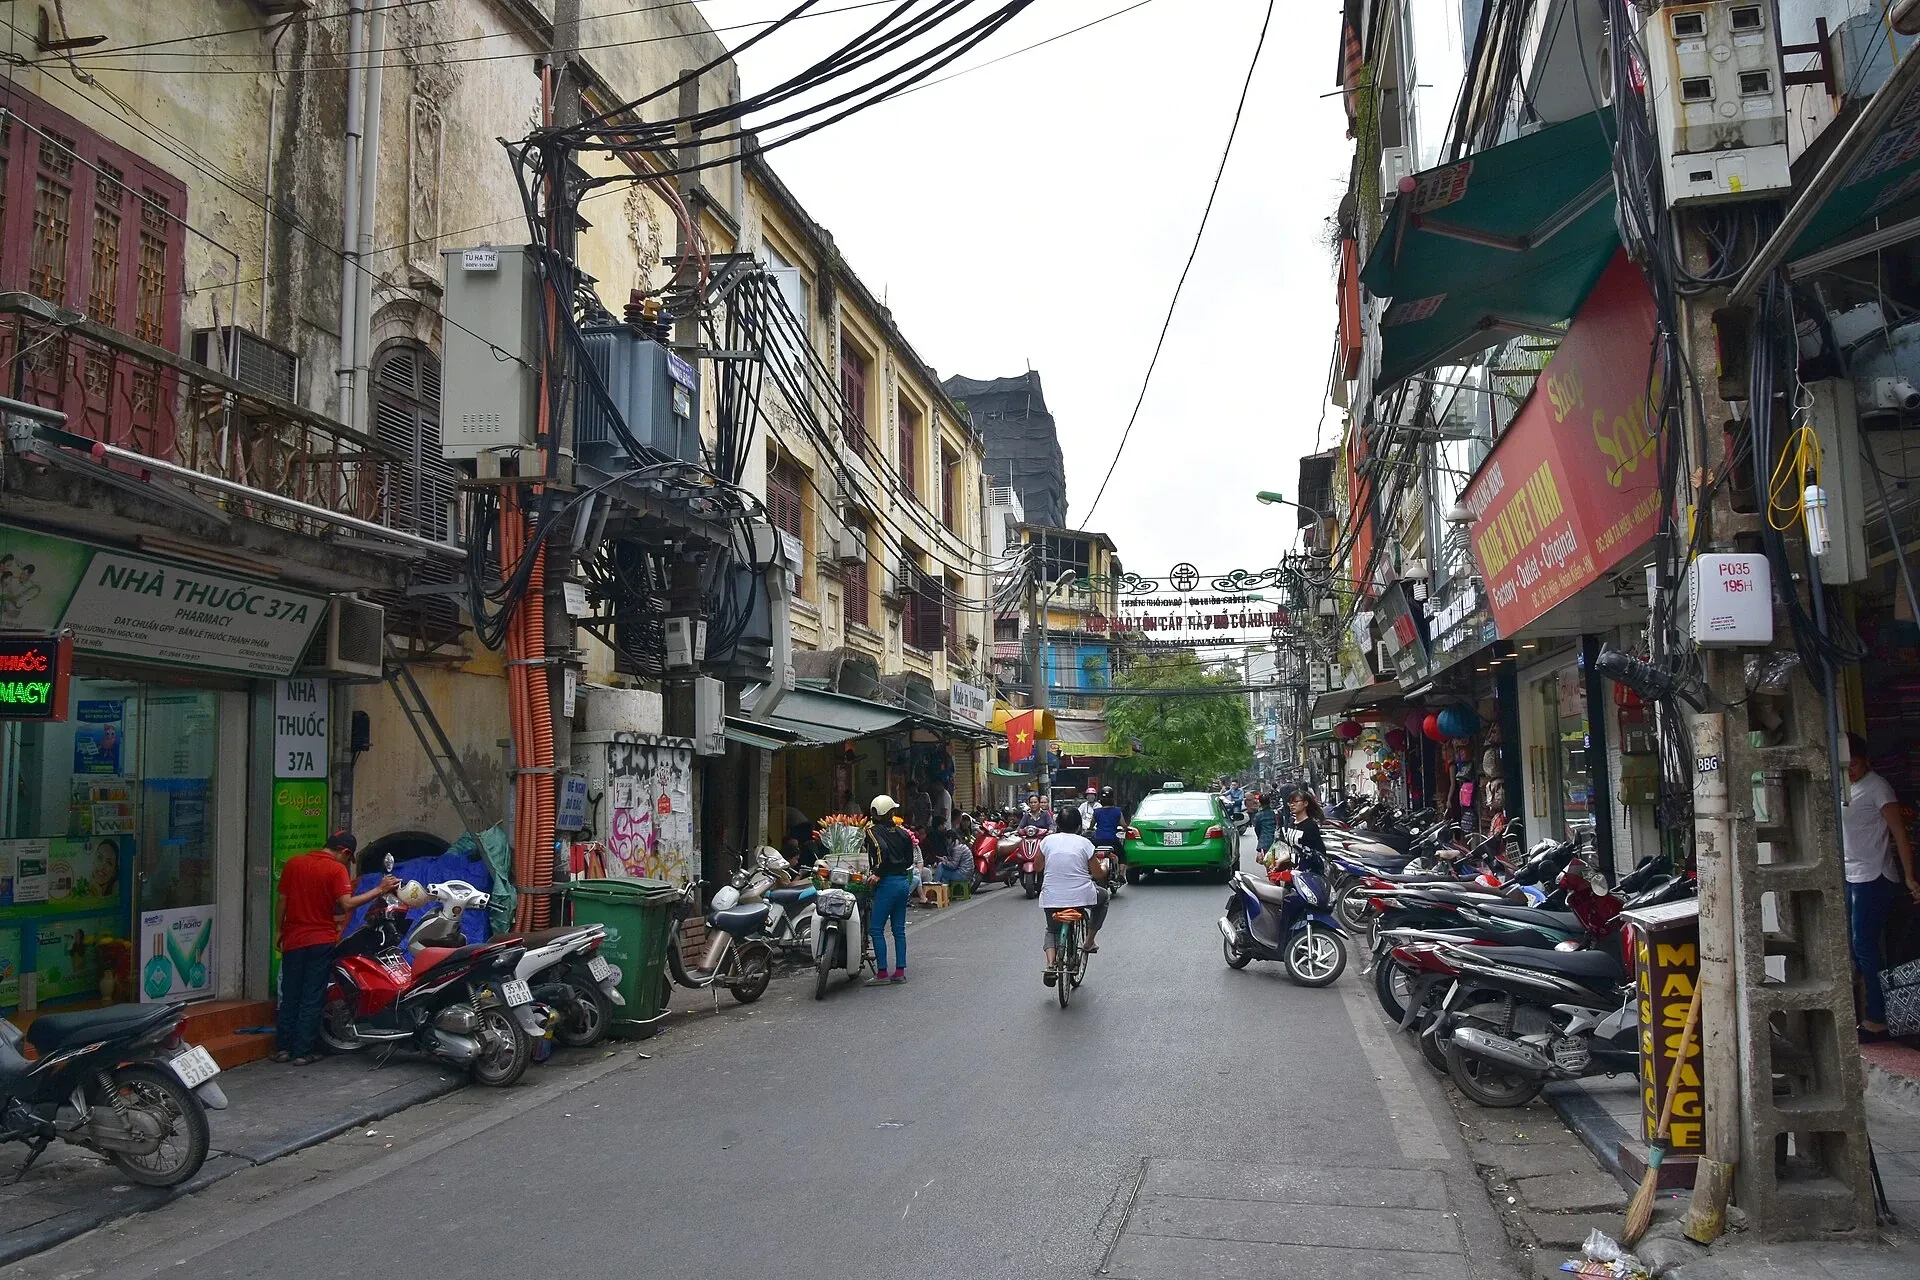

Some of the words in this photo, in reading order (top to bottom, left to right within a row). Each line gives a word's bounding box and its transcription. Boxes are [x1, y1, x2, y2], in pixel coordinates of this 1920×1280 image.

[1478, 520, 1508, 580] MADE
[1497, 509, 1519, 560] IN
[1526, 459, 1564, 531] NAM
[1492, 578, 1518, 610] Factory
[1516, 554, 1542, 590] Outlet
[1541, 520, 1578, 569] Original
[1719, 562, 1750, 576] P035
[99, 564, 165, 597] NHÀ
[173, 578, 265, 616] THUỐC
[264, 598, 309, 625] 37A
[1723, 579, 1753, 593] 195H
[175, 608, 235, 628] PHARMACY
[159, 624, 175, 634] GPP
[203, 630, 228, 643] THUỐC
[287, 678, 317, 703] NHÀ
[953, 685, 964, 706] Made
[969, 690, 984, 712] Vietnam
[277, 711, 325, 737] THUỐC
[288, 752, 314, 771] 37A
[1698, 756, 1718, 771] BBG
[277, 789, 322, 809] Eugica
[1655, 943, 1703, 1148] MASSAGE
[185, 1062, 214, 1084] 5789
